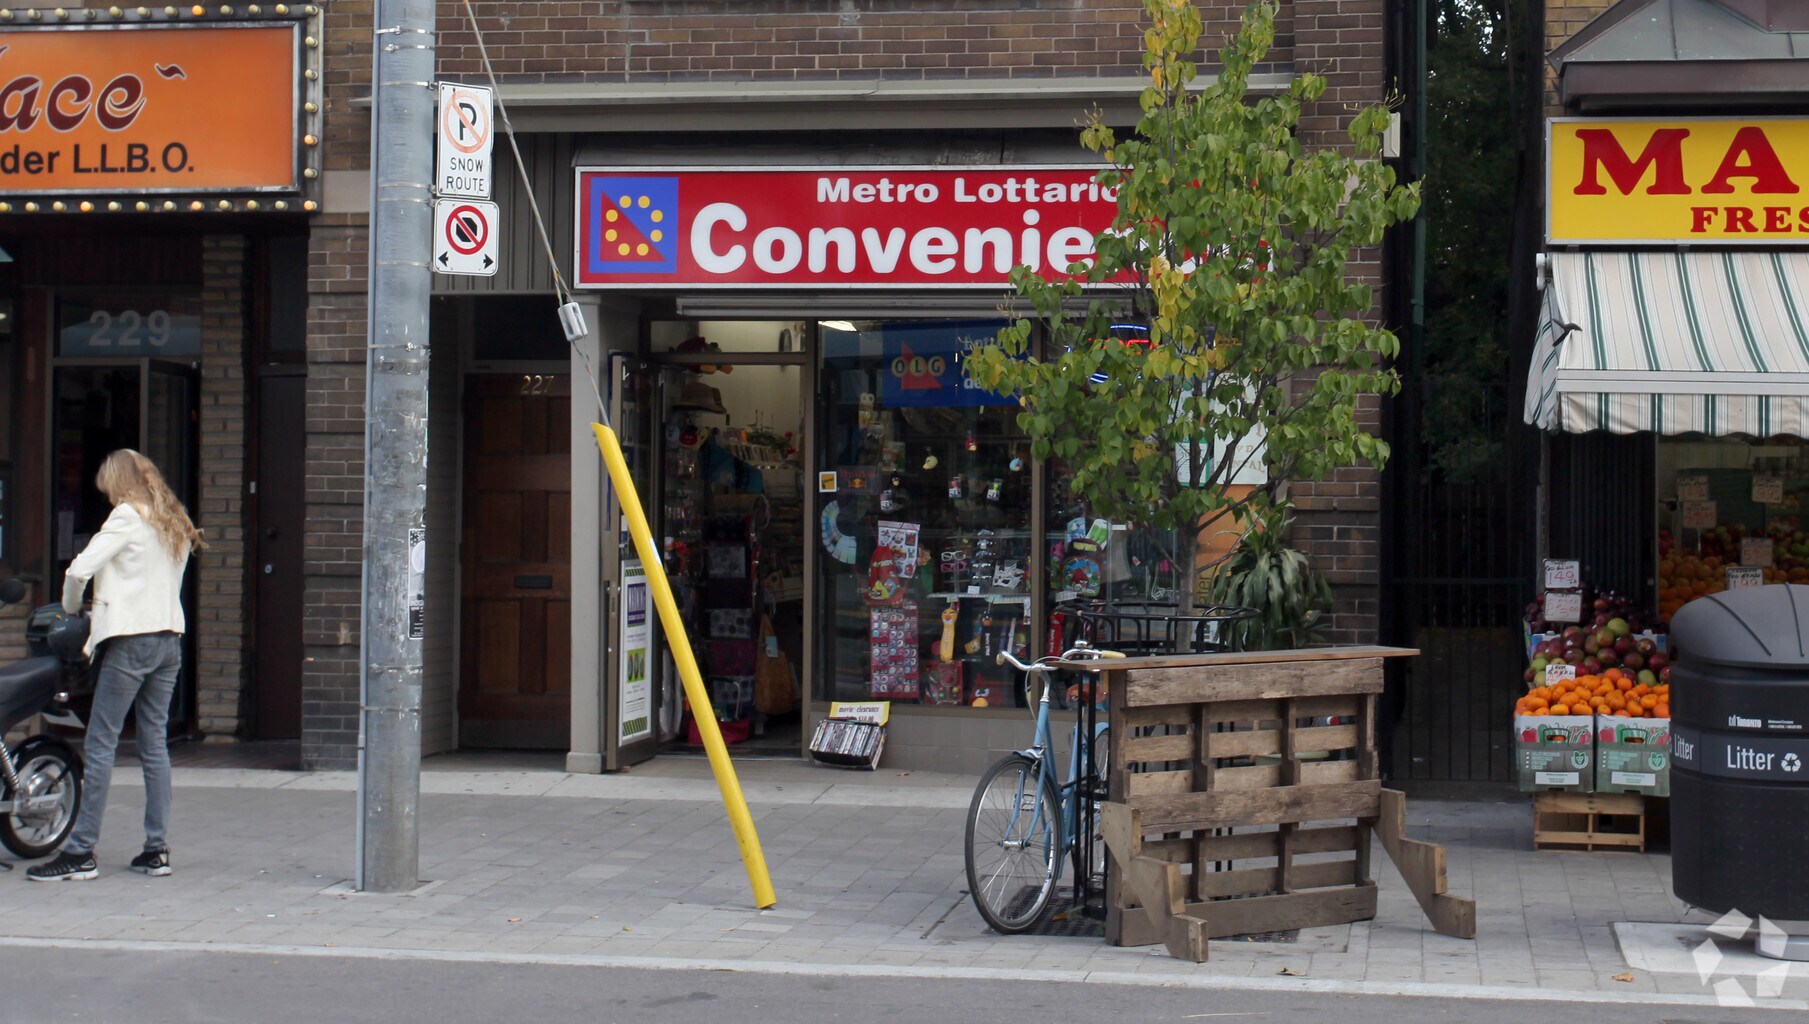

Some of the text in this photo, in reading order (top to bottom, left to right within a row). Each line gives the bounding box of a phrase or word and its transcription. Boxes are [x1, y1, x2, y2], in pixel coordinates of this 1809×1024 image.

[0, 45, 147, 132] ace
[450, 157, 484, 172] SNOW
[446, 176, 484, 191] ROUTE
[817, 177, 939, 203] Metro
[690, 202, 1258, 274] Convenie
[88, 310, 170, 346] 229
[894, 355, 942, 374] OLG
[521, 375, 555, 395] 227
[1674, 734, 1694, 760] Litter
[1727, 745, 1775, 770] Litter
